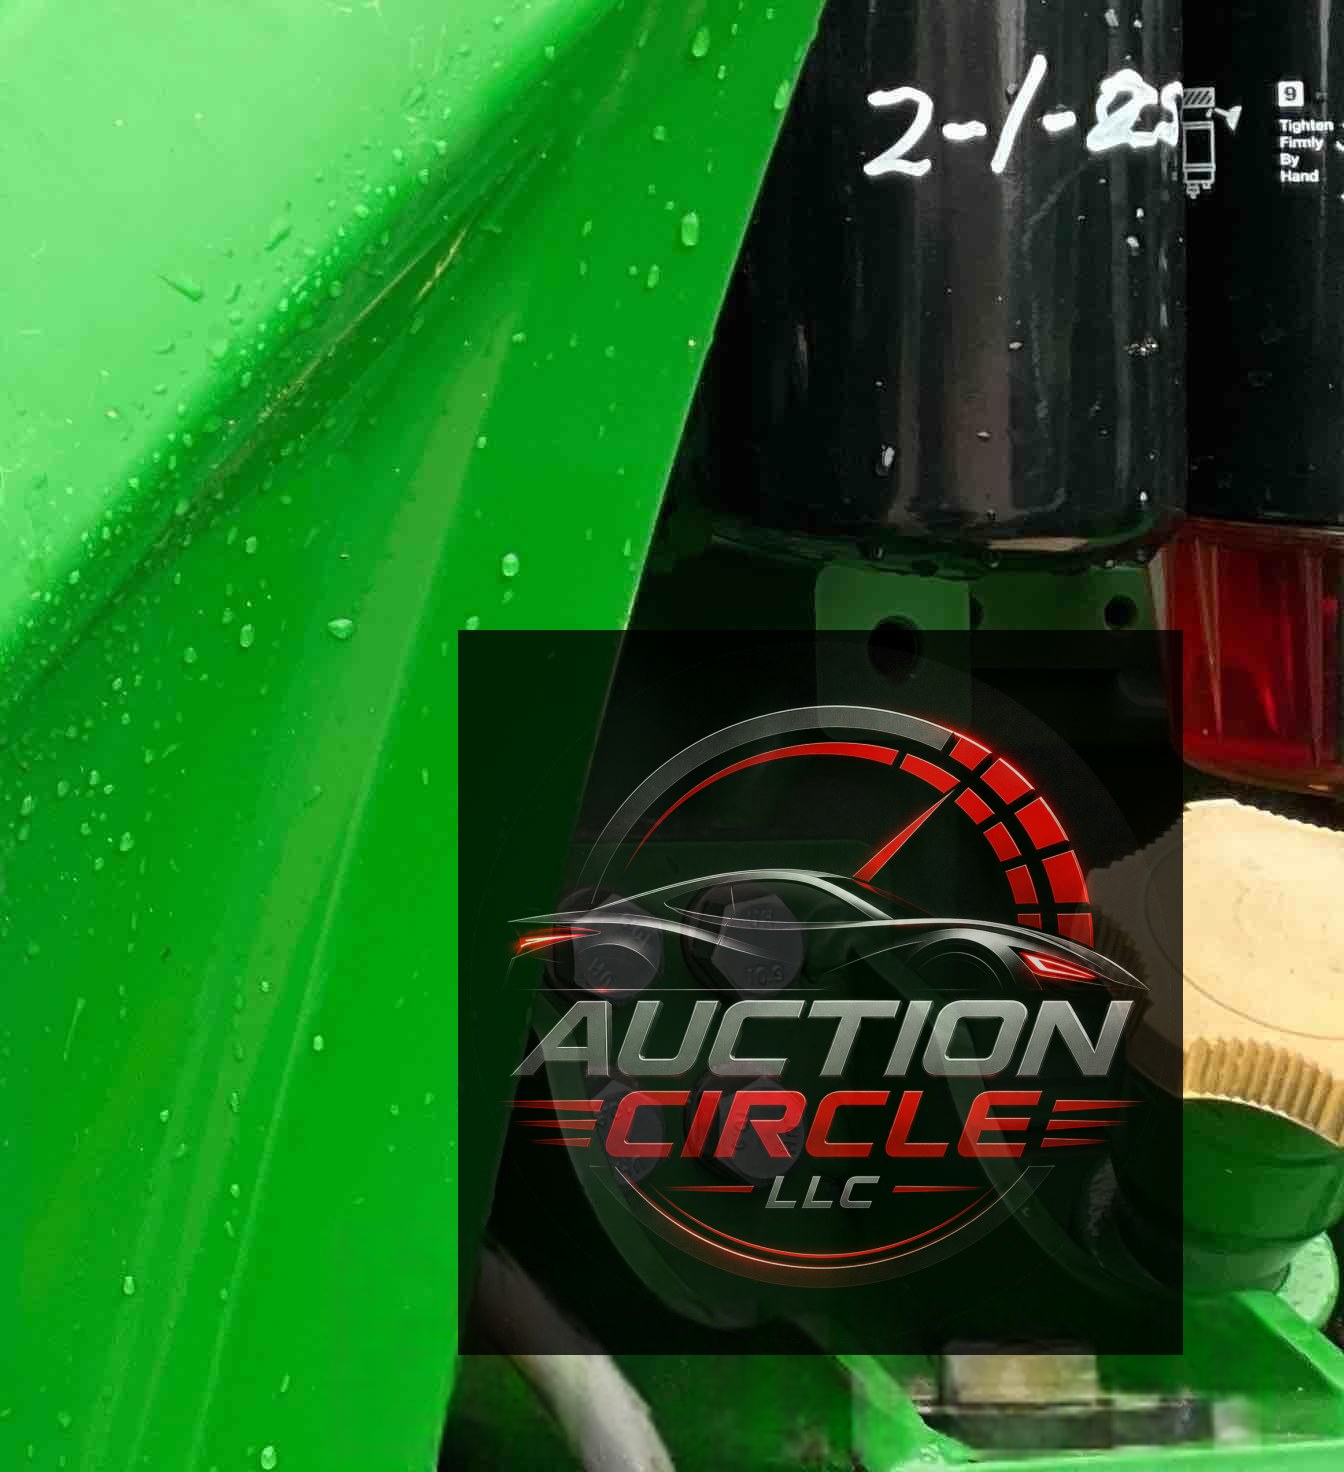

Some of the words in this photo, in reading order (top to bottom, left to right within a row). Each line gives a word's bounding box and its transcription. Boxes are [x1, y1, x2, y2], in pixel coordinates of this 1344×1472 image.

[1279, 119, 1334, 134] Tighten
[1279, 136, 1324, 151] Firmly
[1279, 152, 1300, 168] By
[1280, 169, 1320, 183] Hand
